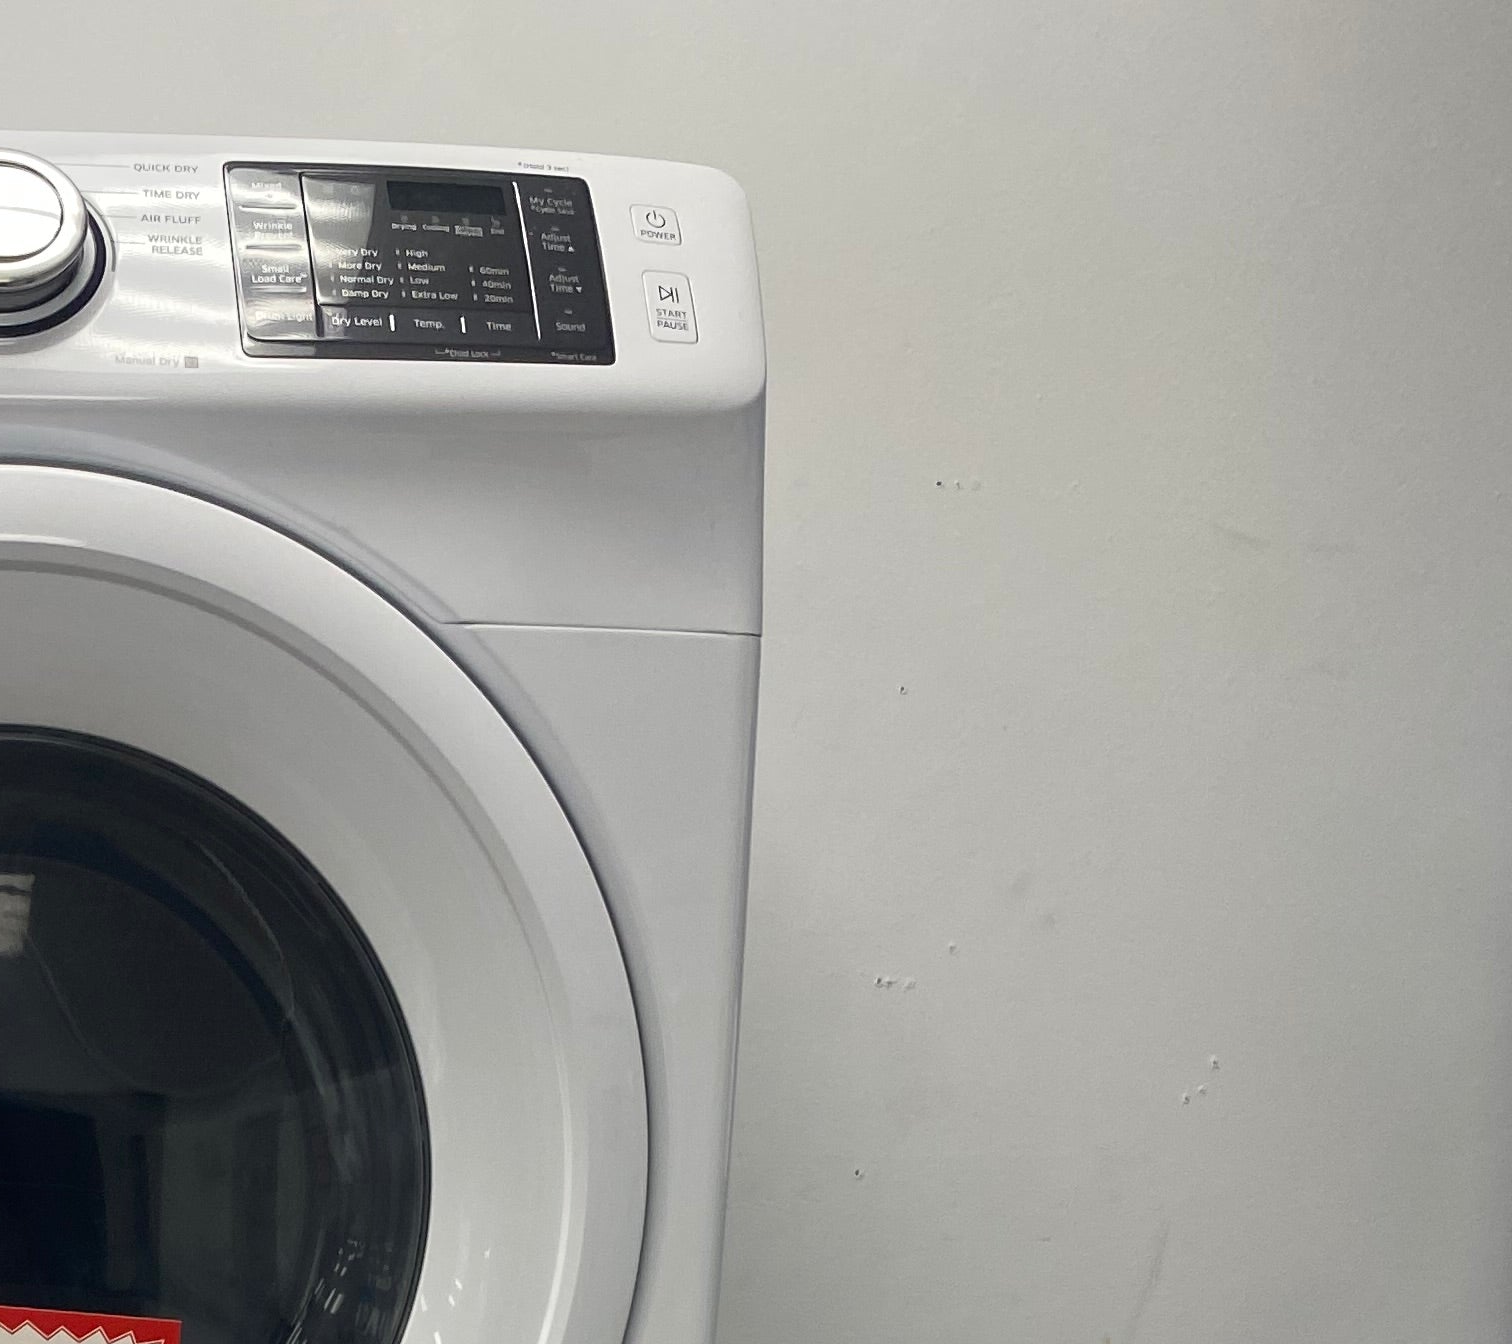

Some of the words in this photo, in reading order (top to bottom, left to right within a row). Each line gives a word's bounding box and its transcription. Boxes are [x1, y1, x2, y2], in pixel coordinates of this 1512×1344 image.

[133, 163, 171, 173] QUICK
[173, 164, 199, 174] DRY
[142, 189, 172, 199] TIME
[175, 190, 201, 200] DRY
[529, 196, 545, 207] My
[546, 197, 573, 209] Cycle
[140, 214, 161, 224] AIR
[165, 215, 202, 225] FLUFF
[253, 220, 293, 230] Wrinkle
[147, 234, 203, 246] WRINKLE
[541, 232, 571, 244] Adjust
[640, 229, 677, 241] POWER
[151, 245, 204, 256] RELEASE
[360, 248, 379, 258] Dry
[405, 248, 429, 258] High
[541, 242, 565, 253] Time
[261, 263, 290, 273] Small
[338, 261, 362, 271] More
[364, 262, 383, 272] Dry
[407, 262, 446, 272] Medium
[251, 274, 277, 284] Load
[339, 275, 374, 284] Normal
[376, 276, 394, 286] Dry
[409, 276, 430, 285] Low
[549, 274, 580, 285] Adjust
[550, 283, 574, 294] Time
[341, 289, 370, 299] Damp
[372, 289, 389, 300] Dry
[411, 290, 437, 300] Extra
[439, 292, 459, 301] Low
[656, 308, 688, 319] START
[331, 316, 351, 328] Dry
[354, 316, 383, 327] Level
[414, 318, 446, 331] Temp.
[486, 321, 512, 332] Time
[555, 321, 586, 332] Sound
[657, 319, 689, 331] PAUSE
[159, 356, 180, 369] Dry
